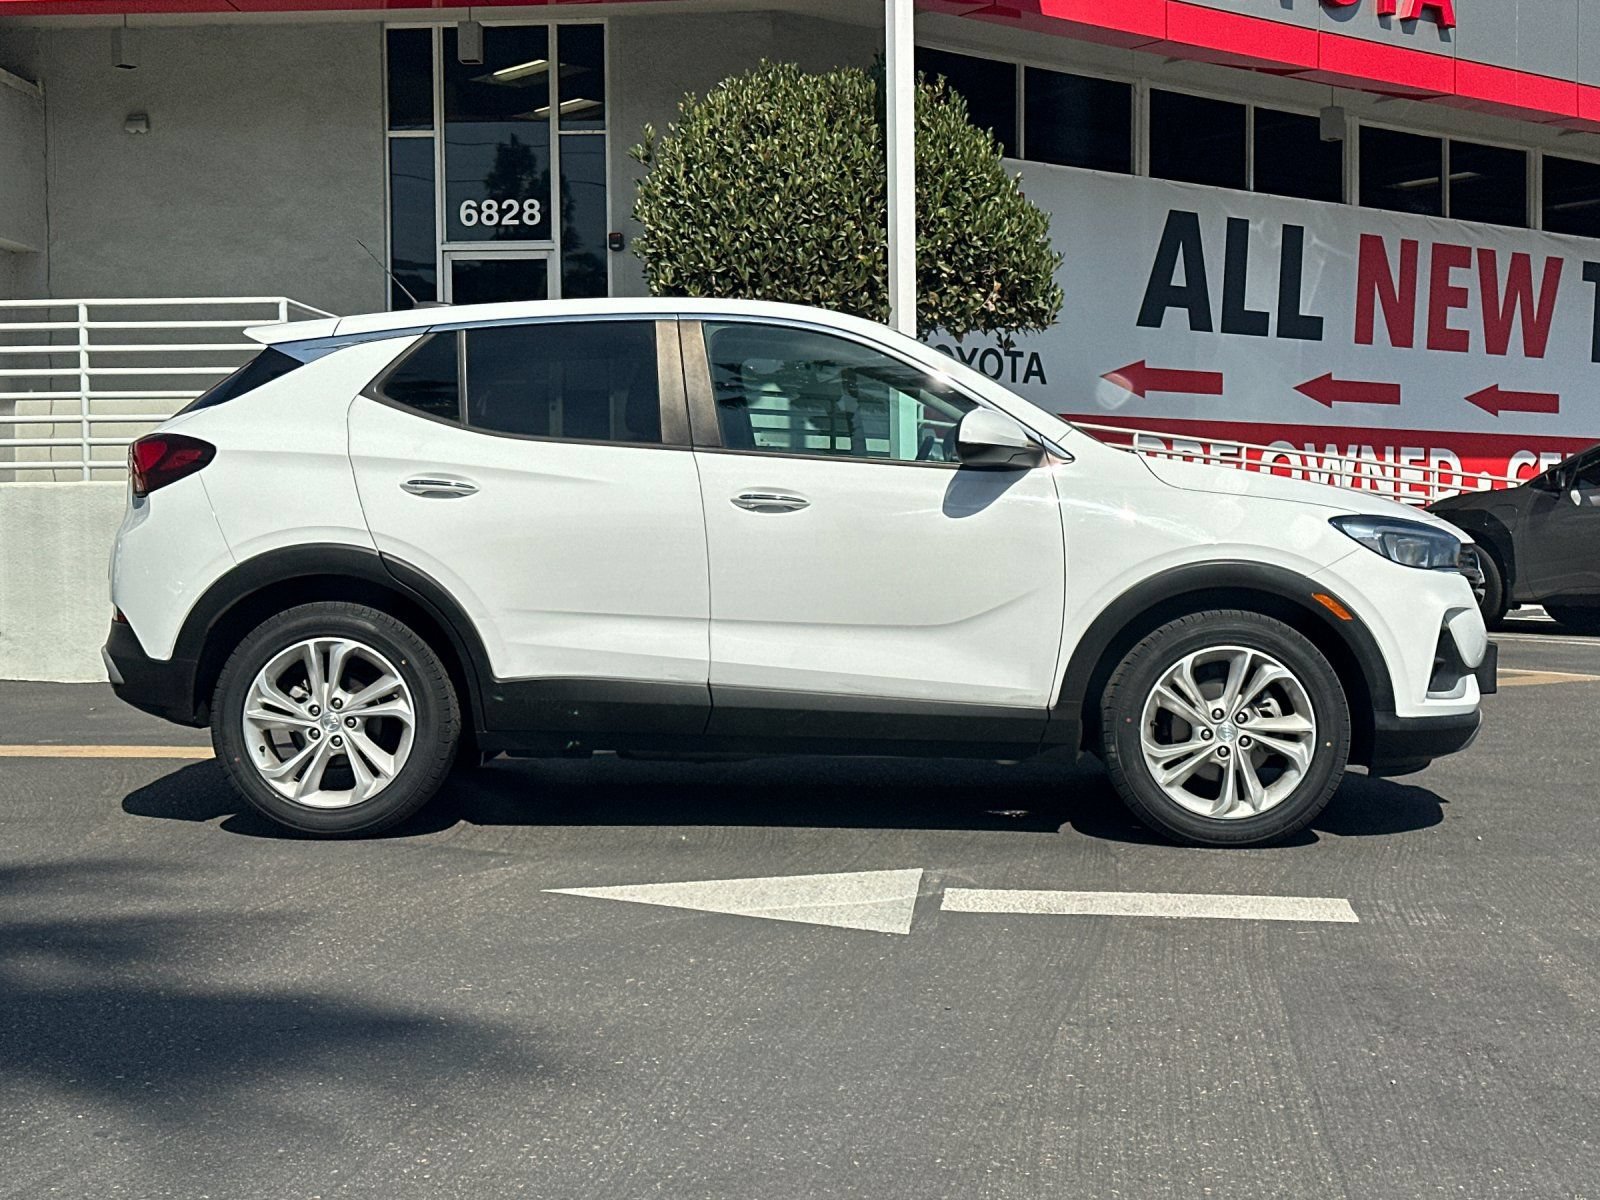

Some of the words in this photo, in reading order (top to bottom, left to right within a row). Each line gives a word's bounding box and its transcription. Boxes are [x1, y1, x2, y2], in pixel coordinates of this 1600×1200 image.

[460, 199, 541, 226] 6828
[1136, 209, 1323, 341] ALL
[1354, 233, 1564, 359] NEW
[935, 344, 1047, 385] YOTA
